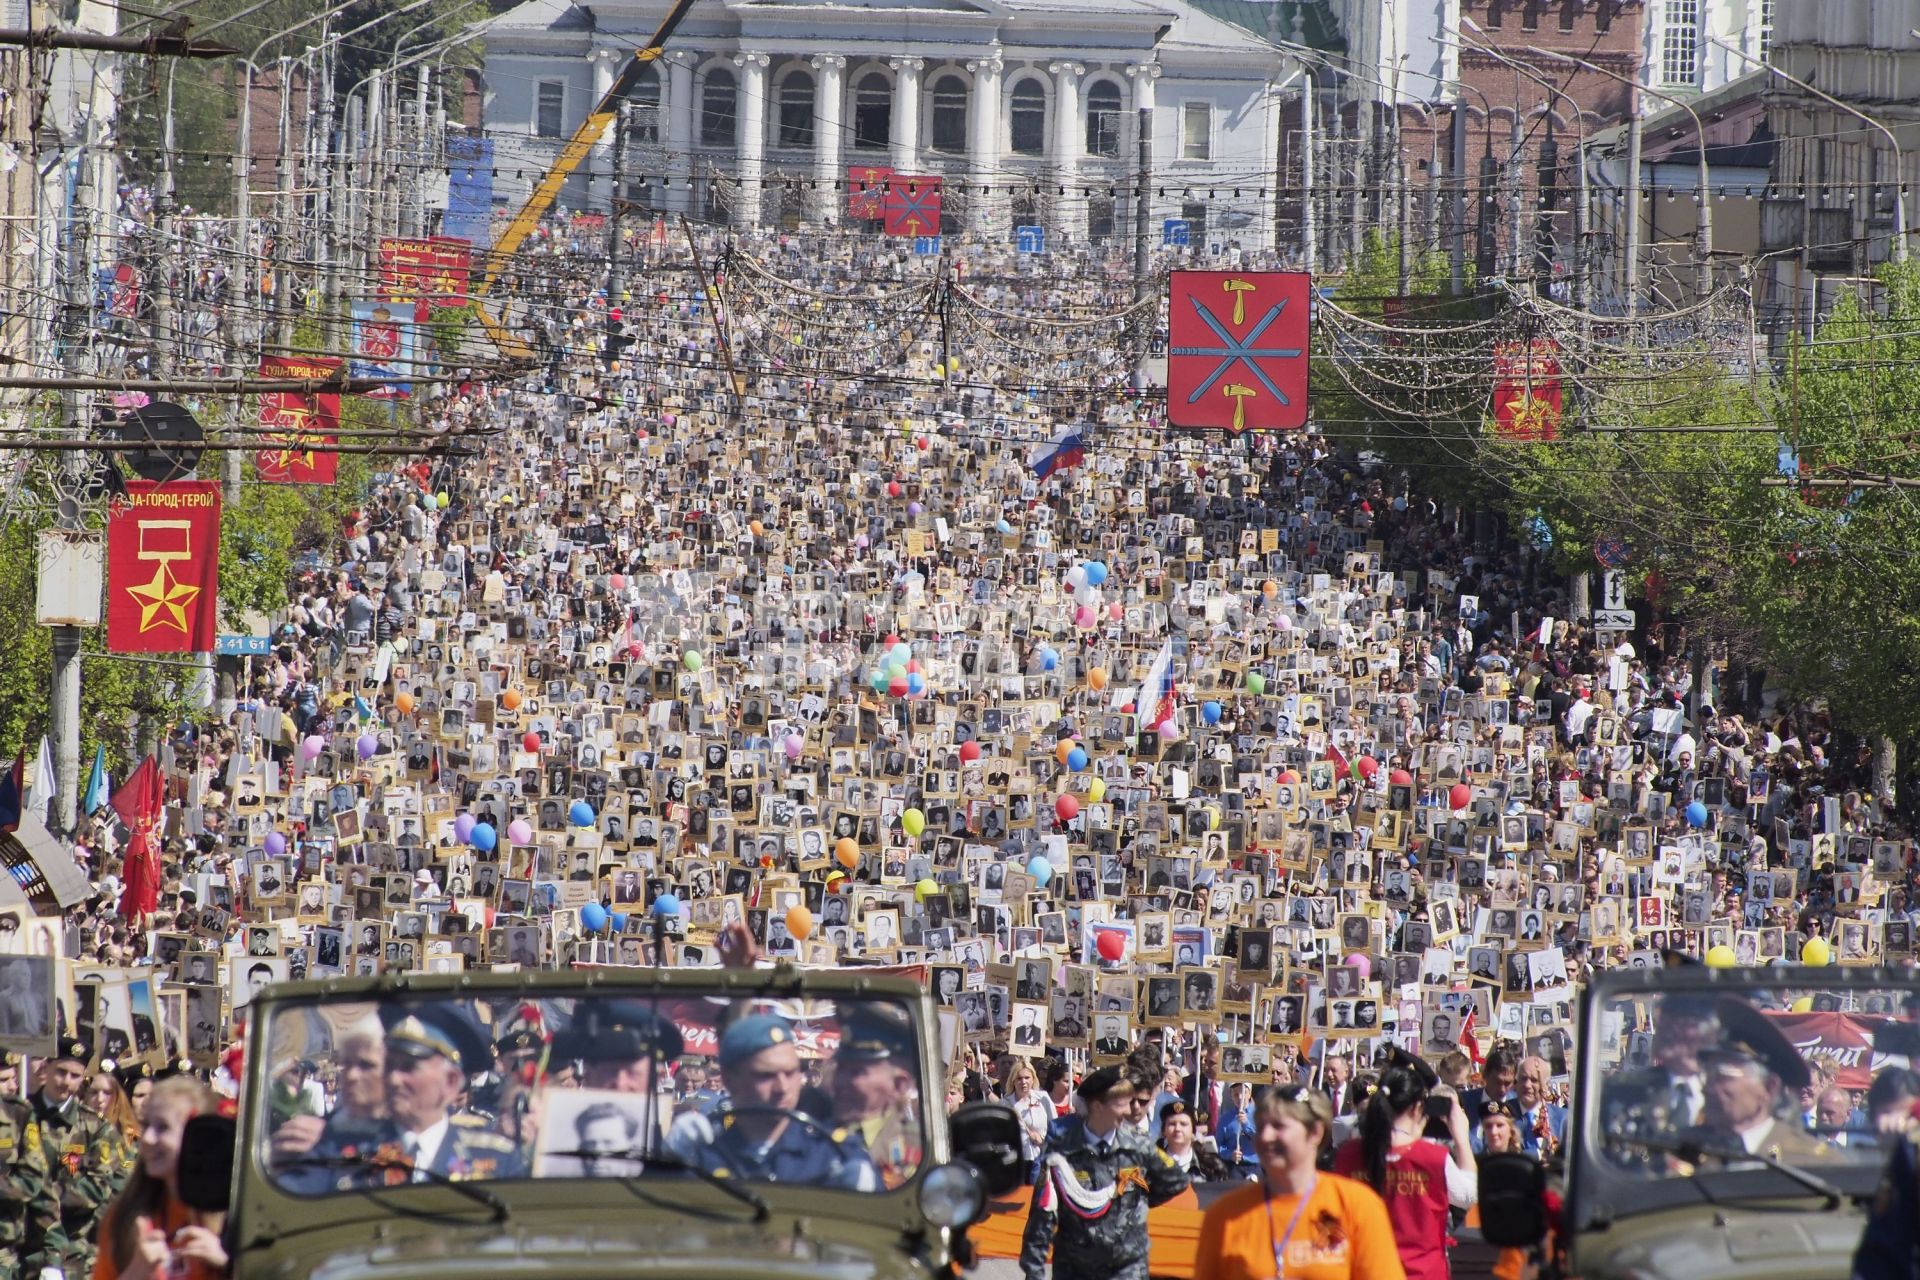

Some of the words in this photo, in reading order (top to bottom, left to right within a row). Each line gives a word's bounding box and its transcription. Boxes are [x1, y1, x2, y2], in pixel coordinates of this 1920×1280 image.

[128, 491, 214, 509] ЛА-ГОРОД-ГЕРОЙ
[227, 638, 243, 650] 41
[249, 638, 265, 650] 61
